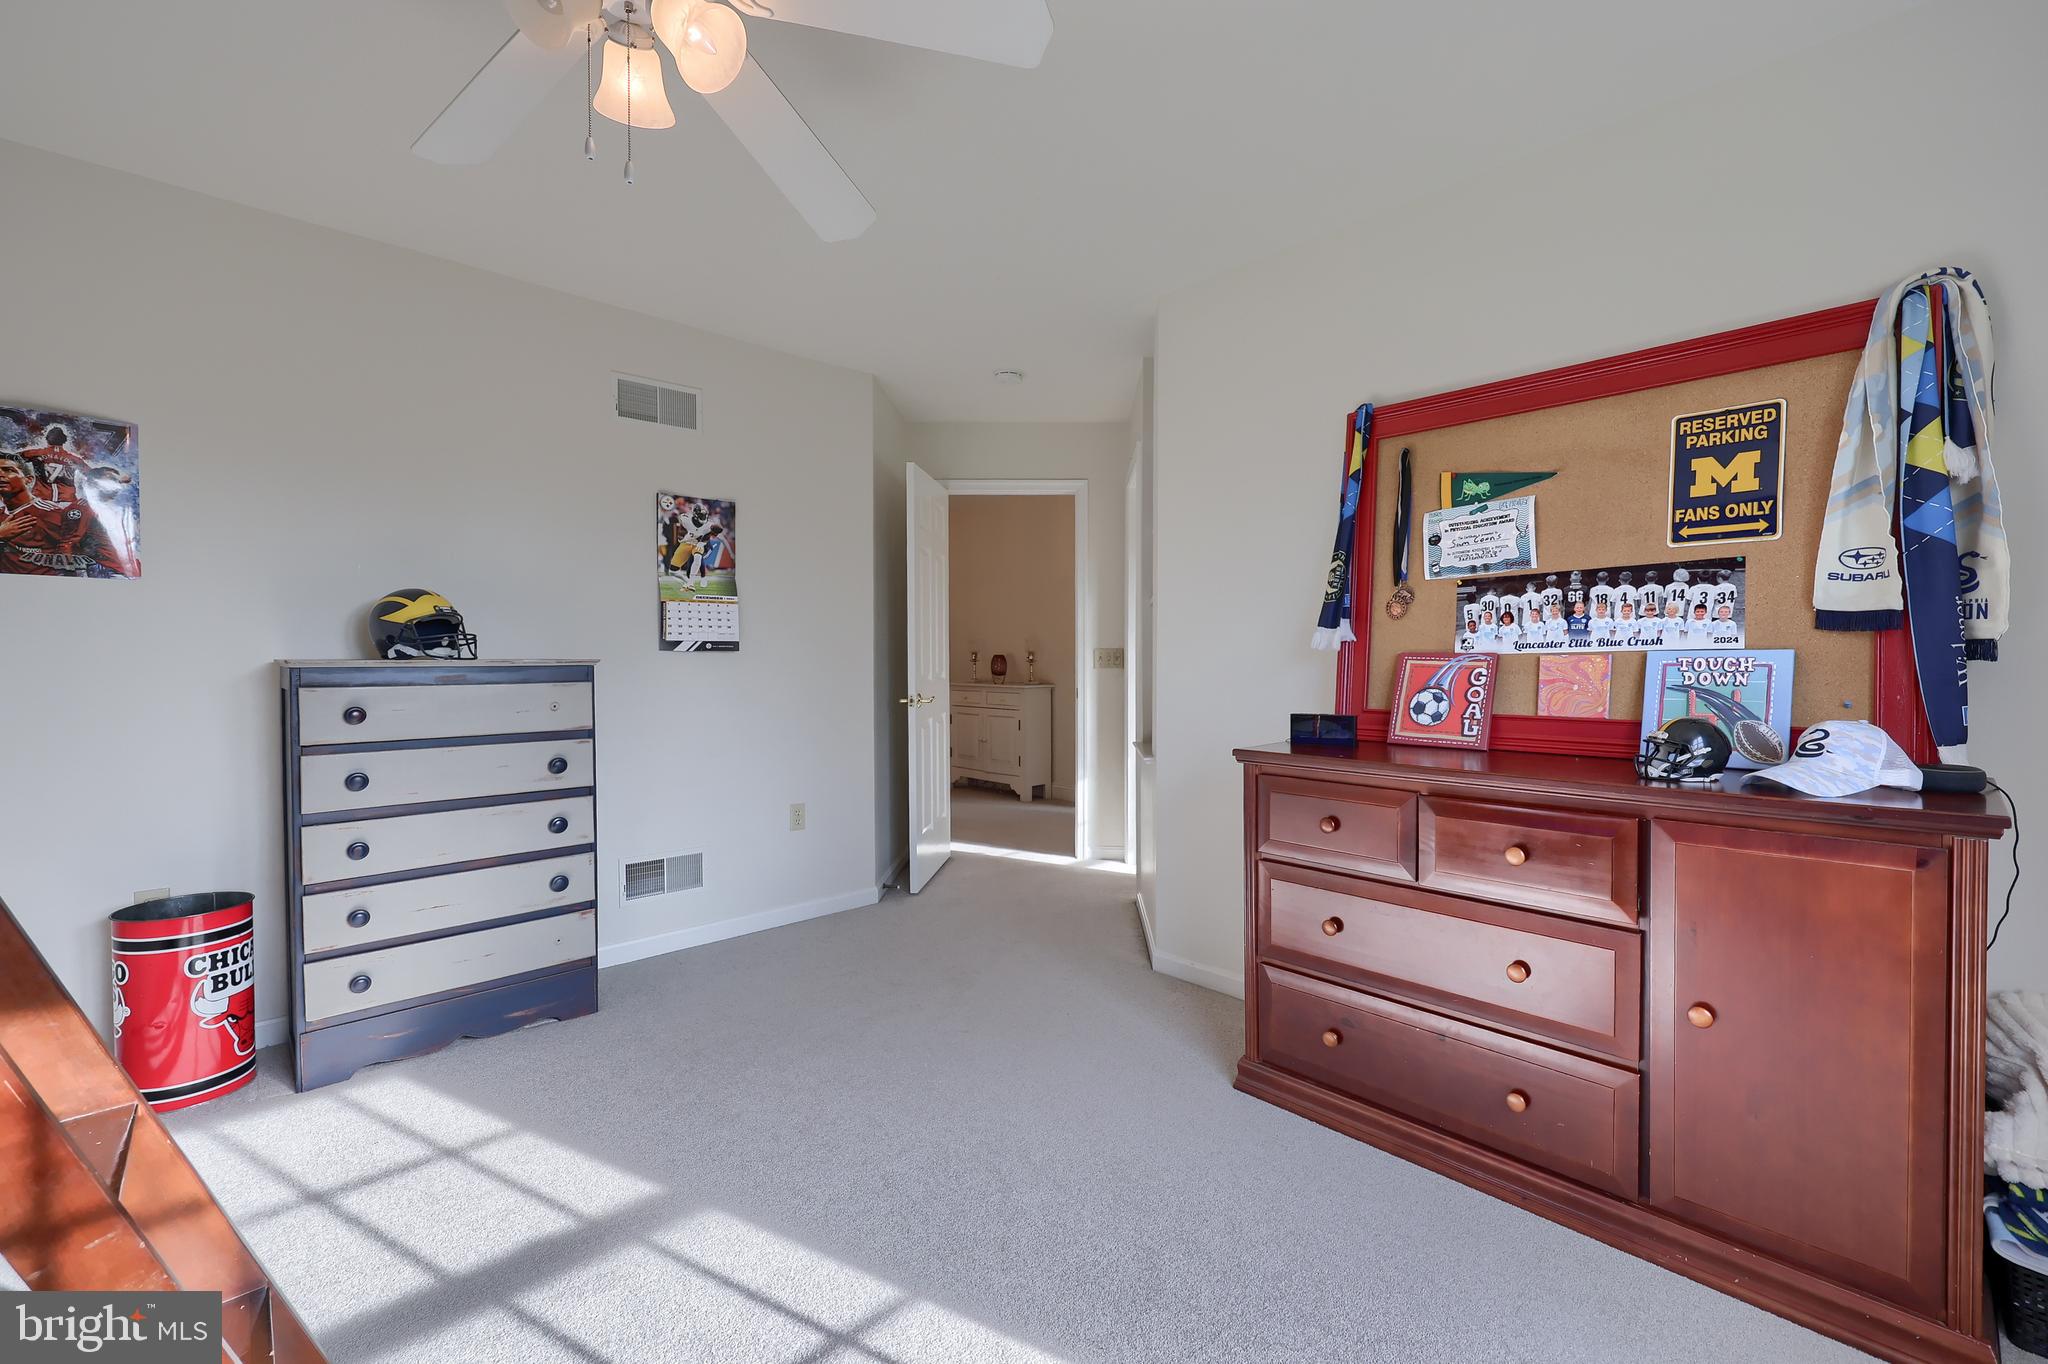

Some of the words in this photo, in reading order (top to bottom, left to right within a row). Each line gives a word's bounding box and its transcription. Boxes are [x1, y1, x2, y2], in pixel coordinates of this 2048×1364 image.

[1679, 407, 1777, 435] RESERVED
[1686, 425, 1768, 449] PARKING
[47, 462, 63, 483] 7
[1689, 450, 1761, 498] M
[1675, 506, 1720, 523] FANS
[1725, 500, 1773, 518] ONLY
[1827, 569, 1890, 582] SUBARU
[1543, 594, 1558, 606] 32
[1567, 590, 1584, 602] 66
[1595, 593, 1608, 604] 18
[1620, 592, 1628, 603] 4
[1644, 590, 1655, 603] 11
[1671, 588, 1685, 601] 14
[1700, 591, 1708, 604] 3
[1717, 590, 1735, 604] 34
[1481, 600, 1494, 611] 30
[1466, 609, 1473, 620] 5
[1513, 639, 1565, 651] Lancaster
[1568, 638, 1593, 648] Elite
[1596, 637, 1624, 647] Blue
[1627, 636, 1663, 646] Crush
[1678, 657, 1755, 672] TOUCH
[1683, 672, 1750, 687] DOWN
[1463, 667, 1488, 737] GOAL
[211, 960, 254, 993] BUL
